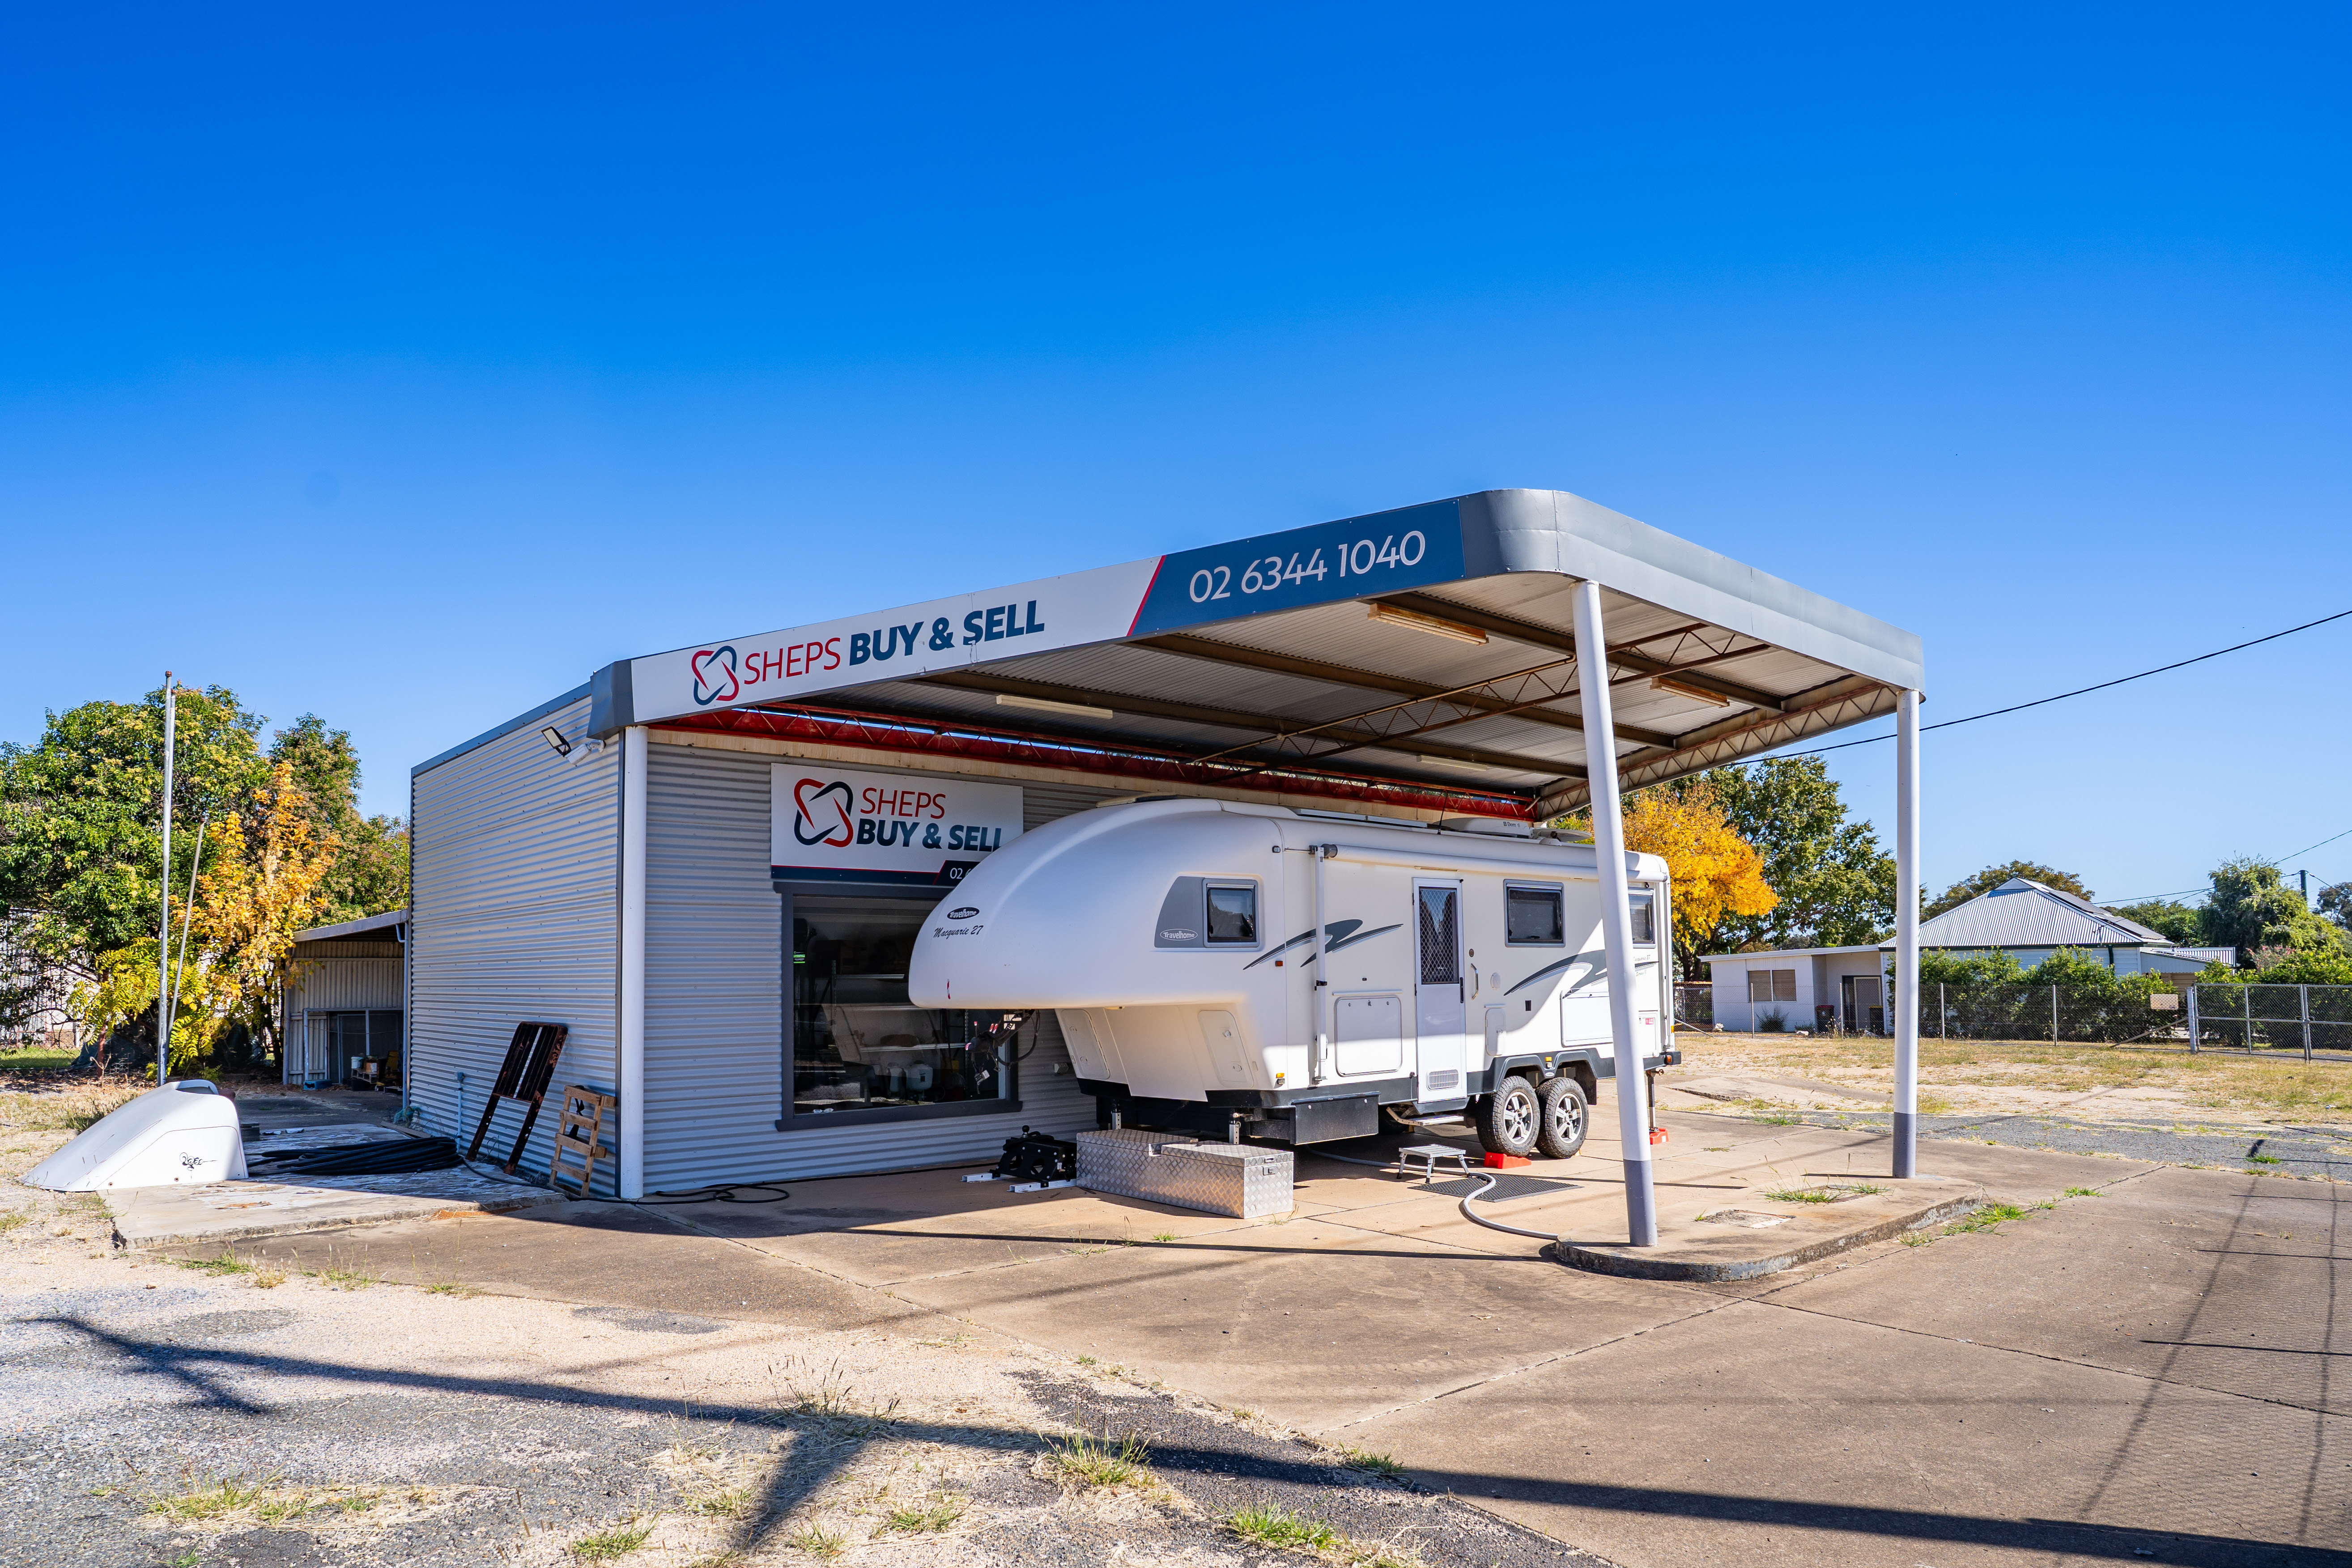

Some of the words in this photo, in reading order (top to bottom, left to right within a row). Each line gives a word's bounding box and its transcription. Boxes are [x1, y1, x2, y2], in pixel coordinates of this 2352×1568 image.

[1189, 566, 1231, 603] 02
[1241, 548, 1327, 594] 6344
[1338, 531, 1425, 577] 1040
[744, 637, 841, 685] SHEPS
[849, 621, 925, 666] BUY
[928, 617, 955, 651] &
[963, 600, 1045, 646] SELL
[860, 787, 946, 819] SHEPS
[856, 818, 921, 847] BUY
[922, 823, 942, 849] &
[948, 824, 1002, 852] SELL
[950, 867, 963, 879] 02
[949, 909, 977, 918] Travelhome
[933, 927, 970, 939] Macquarie
[970, 925, 984, 935] 27
[1163, 931, 1195, 939] Travelhome
